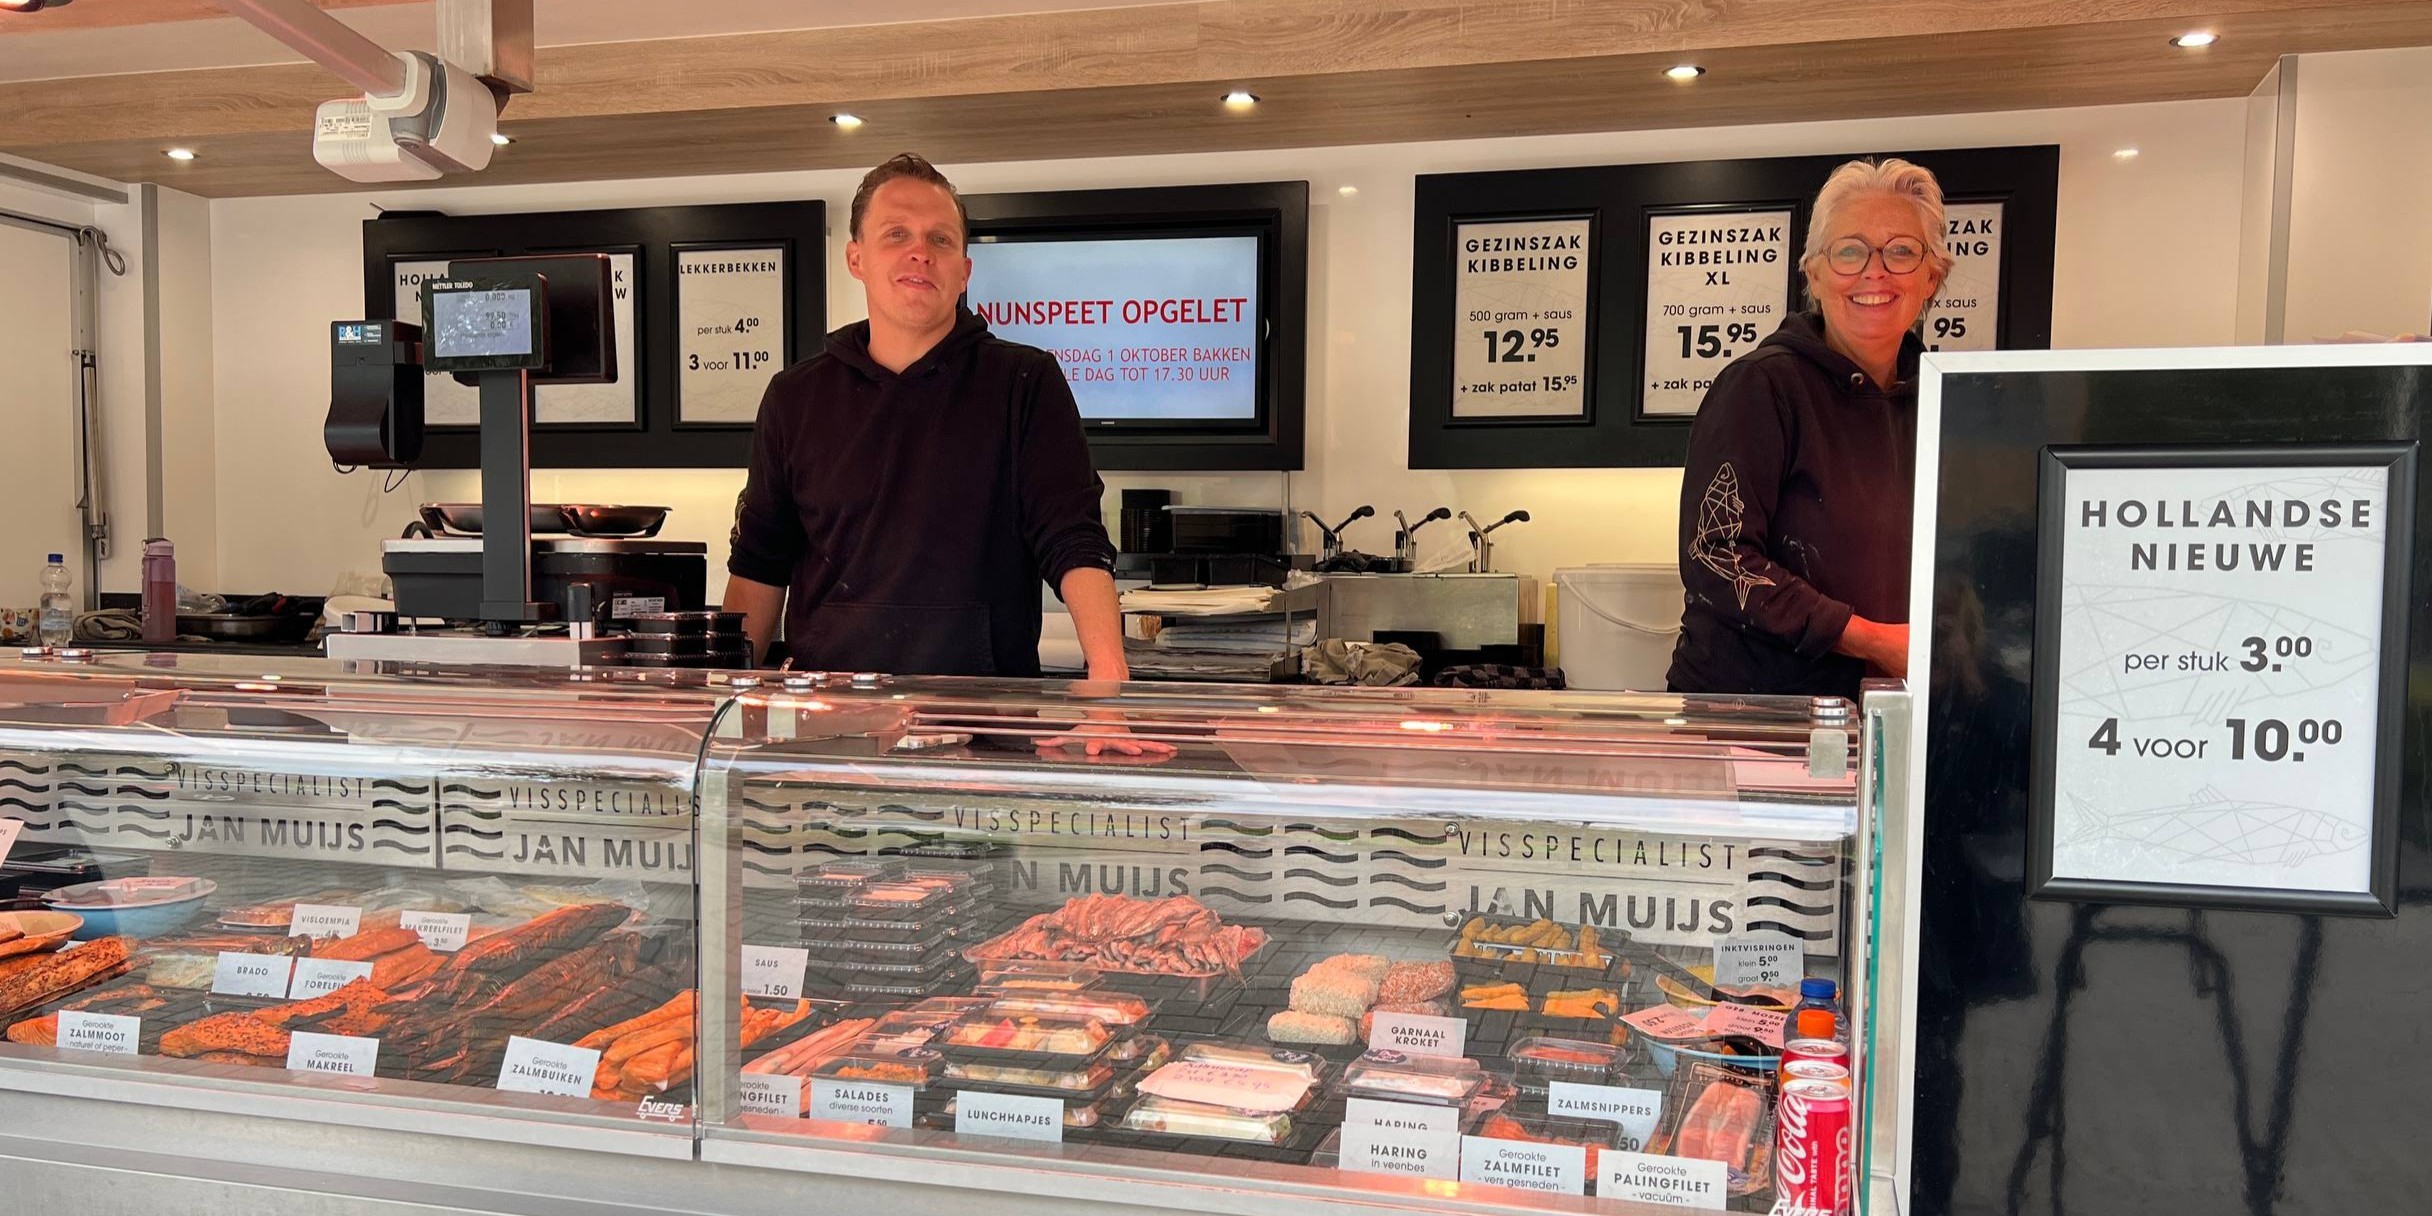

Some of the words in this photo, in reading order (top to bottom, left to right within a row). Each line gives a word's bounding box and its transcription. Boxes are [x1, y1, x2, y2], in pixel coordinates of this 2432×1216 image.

[1949, 219, 1993, 235] ZAK
[1465, 235, 1581, 253] GEZINSZAK
[1658, 227, 1782, 246] GEZINSZAK
[1468, 256, 1578, 273] KIBBELING
[1661, 248, 1778, 267] KIBBELING
[680, 262, 776, 274] LEKKERBEKKEN
[432, 282, 453, 290] METTLER
[454, 281, 473, 289] TOLEDO
[1705, 271, 1730, 286] XL
[1663, 305, 1685, 316] 700
[1689, 304, 1724, 318] gram
[1741, 303, 1771, 314] saus
[1945, 298, 1977, 309] saus
[977, 300, 1114, 326] NUNSPEET
[1122, 298, 1248, 325] OPGELET
[1469, 311, 1491, 322] 500
[1495, 311, 1528, 323] gram
[1543, 309, 1572, 320] saus
[697, 326, 712, 336] per
[715, 325, 732, 334] stuk
[1483, 328, 1559, 364] 12.95
[1677, 322, 1757, 359] 15.95
[689, 354, 699, 371] 3
[703, 361, 728, 370] voor
[1107, 349, 1114, 362] 1
[1120, 348, 1188, 363] OKTOBER
[1193, 347, 1251, 362] BAKKEN
[1085, 367, 1115, 382] DAG
[1120, 367, 1149, 381] TOT
[1155, 367, 1194, 381] 17.30
[1200, 366, 1230, 381] UUR
[1472, 382, 1495, 393] zak
[1499, 381, 1536, 395] patat
[1542, 375, 1577, 392] 15.95
[1663, 378, 1688, 390] zak
[1693, 379, 1714, 392] pa
[2081, 499, 2371, 529] HOLLANDSE
[2131, 543, 2314, 572] NIEUWE
[2125, 653, 2169, 674] per
[2178, 651, 2229, 672] stuk
[2240, 636, 2312, 673] 3.00
[2088, 718, 2122, 756] 4
[2133, 738, 2209, 760] voor
[2226, 718, 2343, 762] 10.00
[177, 770, 365, 799] VISSPECIALIST
[509, 786, 700, 817] VISSPECIALIS
[954, 808, 1191, 841] VISSPECIALIST
[178, 814, 245, 843] JAN
[260, 817, 365, 851] MUIJS
[512, 833, 587, 867] JAN
[603, 838, 692, 871] MUIJ
[1459, 831, 1735, 870] VISSPECIALIST
[1058, 861, 1190, 898] MUIJS
[1458, 885, 1555, 922] JAN
[1579, 891, 1734, 935] MUIJS
[301, 915, 350, 926] VISLOEMPIA
[405, 924, 463, 935] MAKREELFILET
[1721, 943, 1796, 953] INKTVISRINGEN
[755, 958, 778, 968] SAUS
[1738, 959, 1757, 968] klein
[236, 966, 269, 976] BRADO
[317, 972, 347, 981] Gerookte
[1737, 975, 1759, 984] groot
[764, 983, 788, 996] 1.50
[82, 1019, 115, 1029] Gerookte
[70, 1029, 126, 1042] ZALMMOOT
[1391, 1026, 1446, 1039] GARNAAL
[103, 1044, 124, 1053] peper
[1395, 1036, 1440, 1048] KROKET
[315, 1049, 349, 1060] Gerookte
[307, 1059, 354, 1073] MAKREEL
[532, 1056, 567, 1069] Gerookte
[512, 1063, 582, 1085] ZALMBUIKEN
[740, 1081, 769, 1090] rookte
[740, 1091, 788, 1105] NGFILET
[834, 1088, 889, 1103] SALADES
[829, 1101, 859, 1112] diverse
[861, 1104, 893, 1115] soorten
[1557, 1099, 1652, 1117] ZALMSNIPPERS
[967, 1109, 1051, 1126] LUNCHHAPJES
[1619, 1136, 1640, 1151] 50
[1370, 1144, 1428, 1160] HARING
[1499, 1148, 1547, 1163] Gerookte
[1383, 1161, 1425, 1173] veenbes
[1484, 1159, 1561, 1179] ZALMFILET
[1637, 1162, 1688, 1177] Gerookte
[1484, 1176, 1504, 1186] vers
[1506, 1177, 1560, 1192] gesneden
[1613, 1173, 1711, 1194] PALINGFILET
